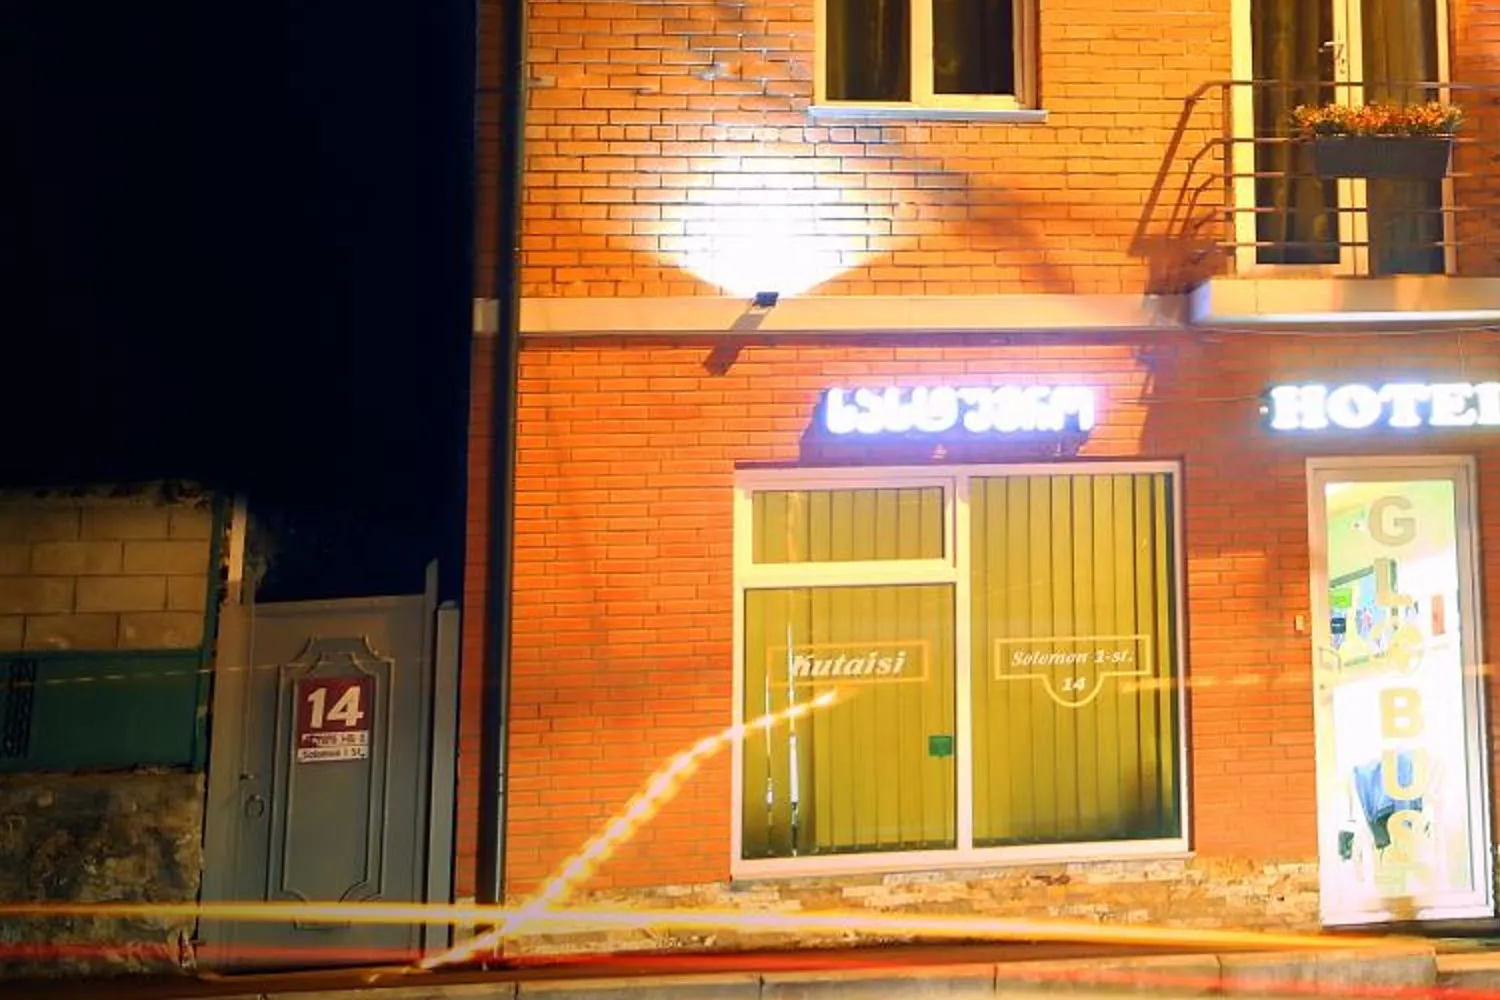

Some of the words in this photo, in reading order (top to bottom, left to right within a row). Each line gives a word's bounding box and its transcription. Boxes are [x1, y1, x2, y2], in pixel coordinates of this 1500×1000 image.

[827, 385, 1094, 433] სასტუმრო
[1061, 676, 1087, 692] 14
[307, 686, 365, 729] 14
